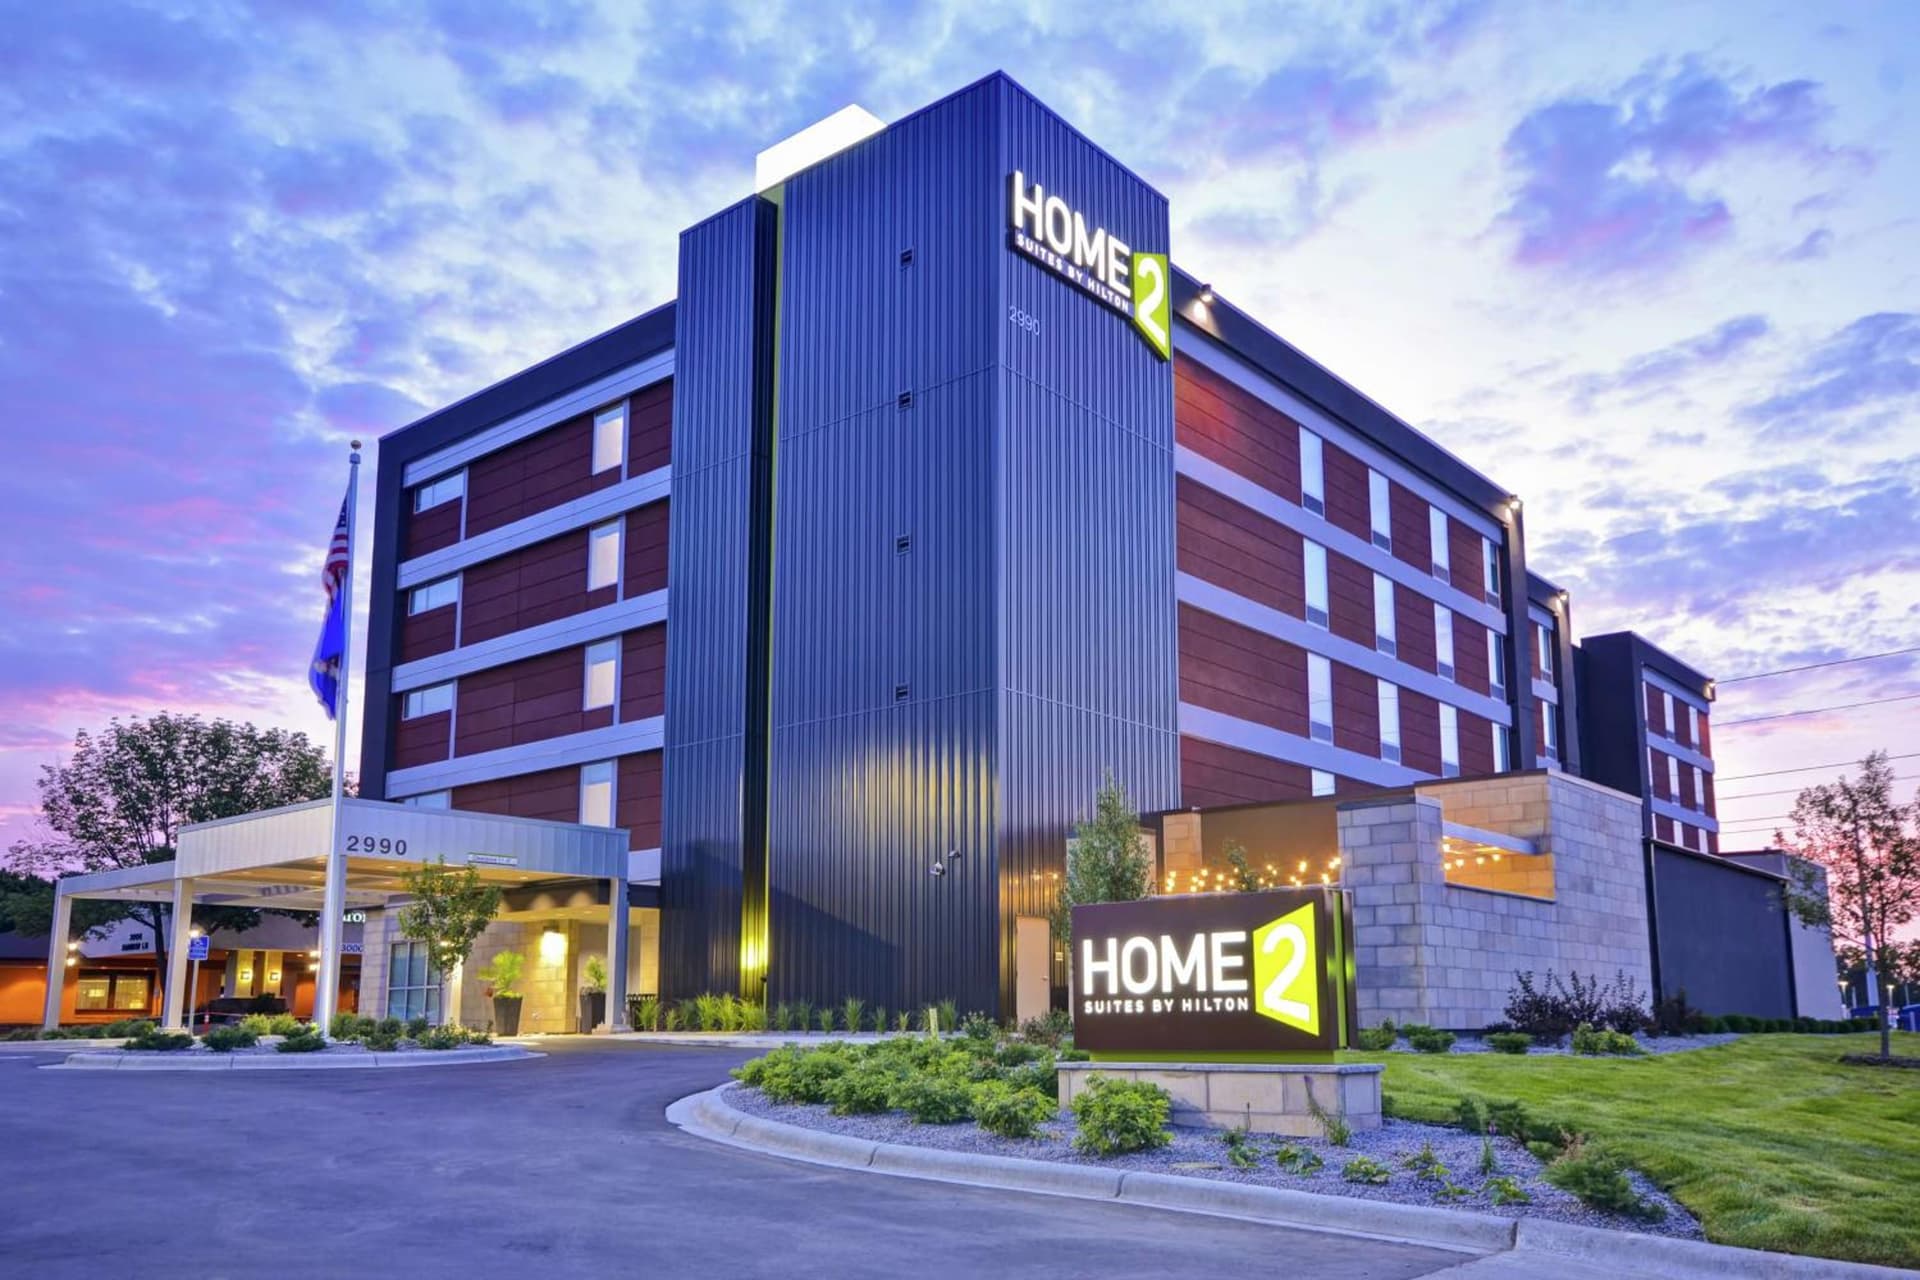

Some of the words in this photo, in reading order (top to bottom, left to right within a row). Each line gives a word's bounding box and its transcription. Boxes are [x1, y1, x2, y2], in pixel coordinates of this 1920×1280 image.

[1014, 170, 1131, 298] HOME
[1137, 257, 1167, 347] 2
[1017, 233, 1063, 271] SUITES
[1068, 265, 1083, 285] BY
[1088, 276, 1128, 313] HILTON
[1009, 306, 1040, 335] 2990
[347, 835, 407, 855] 2990
[1082, 931, 1249, 995] HOME
[1262, 922, 1311, 1022] 2
[1084, 999, 1145, 1014] SUITES
[1153, 999, 1174, 1013] BY
[1183, 997, 1249, 1012] HILTON
